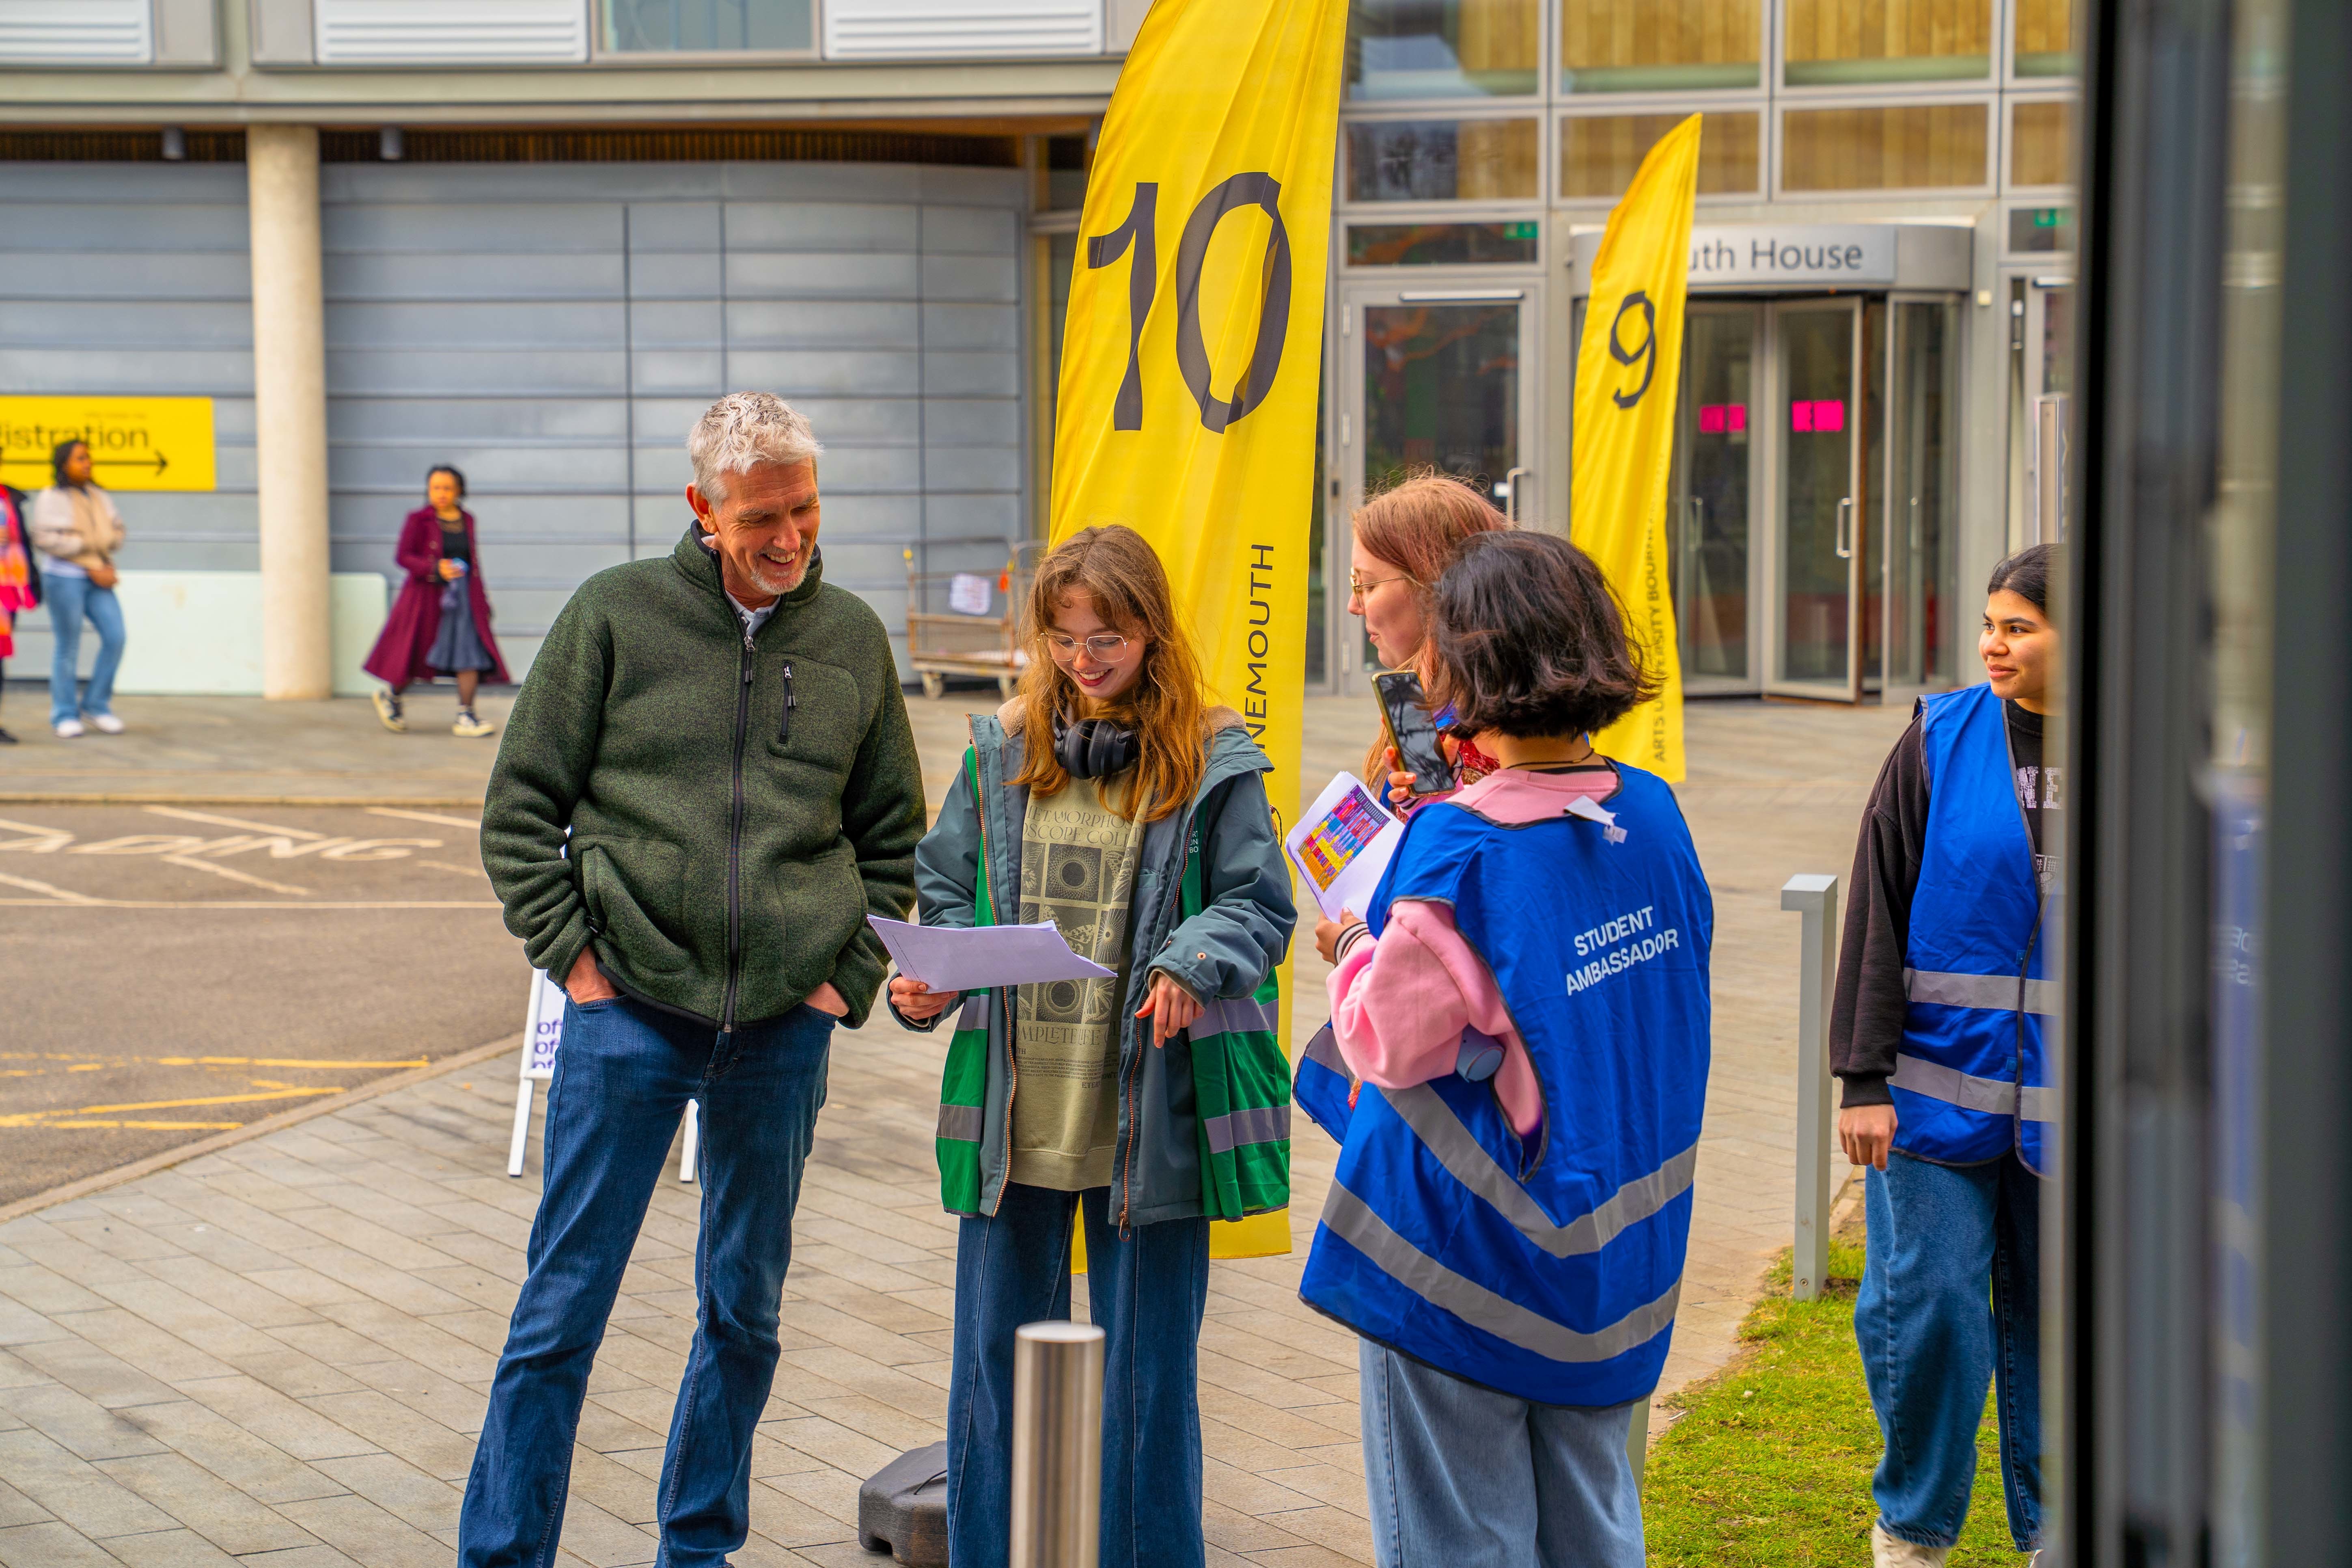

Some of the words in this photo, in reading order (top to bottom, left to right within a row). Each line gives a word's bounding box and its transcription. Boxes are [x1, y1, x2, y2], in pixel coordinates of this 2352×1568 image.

[1750, 238, 1863, 271] House
[1087, 172, 1291, 434] 10
[1609, 291, 1656, 410] 9
[0, 421, 150, 451] istration
[1245, 544, 1274, 749] NEMOUTH
[1652, 714, 1666, 763] ARTS
[1574, 906, 1653, 956] STUDENT
[1566, 929, 1679, 996] AMBASSADOR
